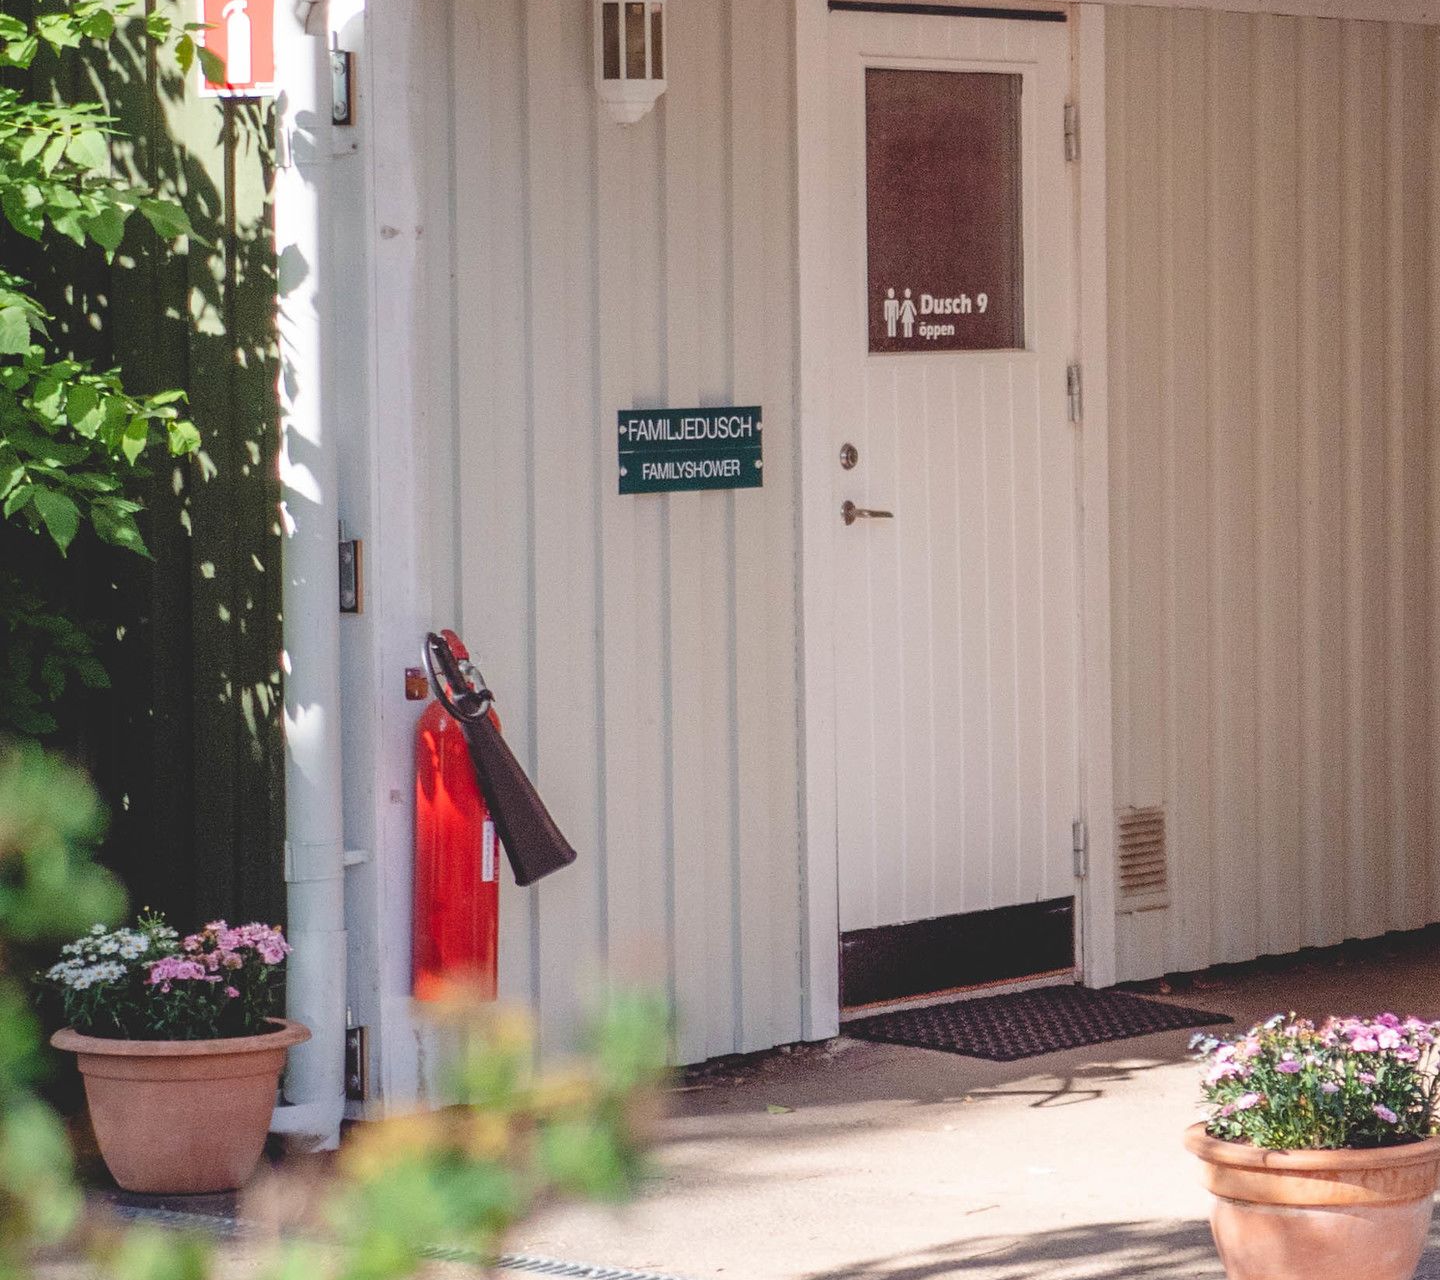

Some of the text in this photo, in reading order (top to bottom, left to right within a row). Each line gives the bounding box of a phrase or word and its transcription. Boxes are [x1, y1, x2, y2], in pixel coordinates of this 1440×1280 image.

[919, 292, 988, 315] Dusch 9
[918, 321, 955, 340] öppen
[628, 416, 753, 442] FAMILJEDUSCH
[642, 459, 741, 481] FAMILYSHOWER
